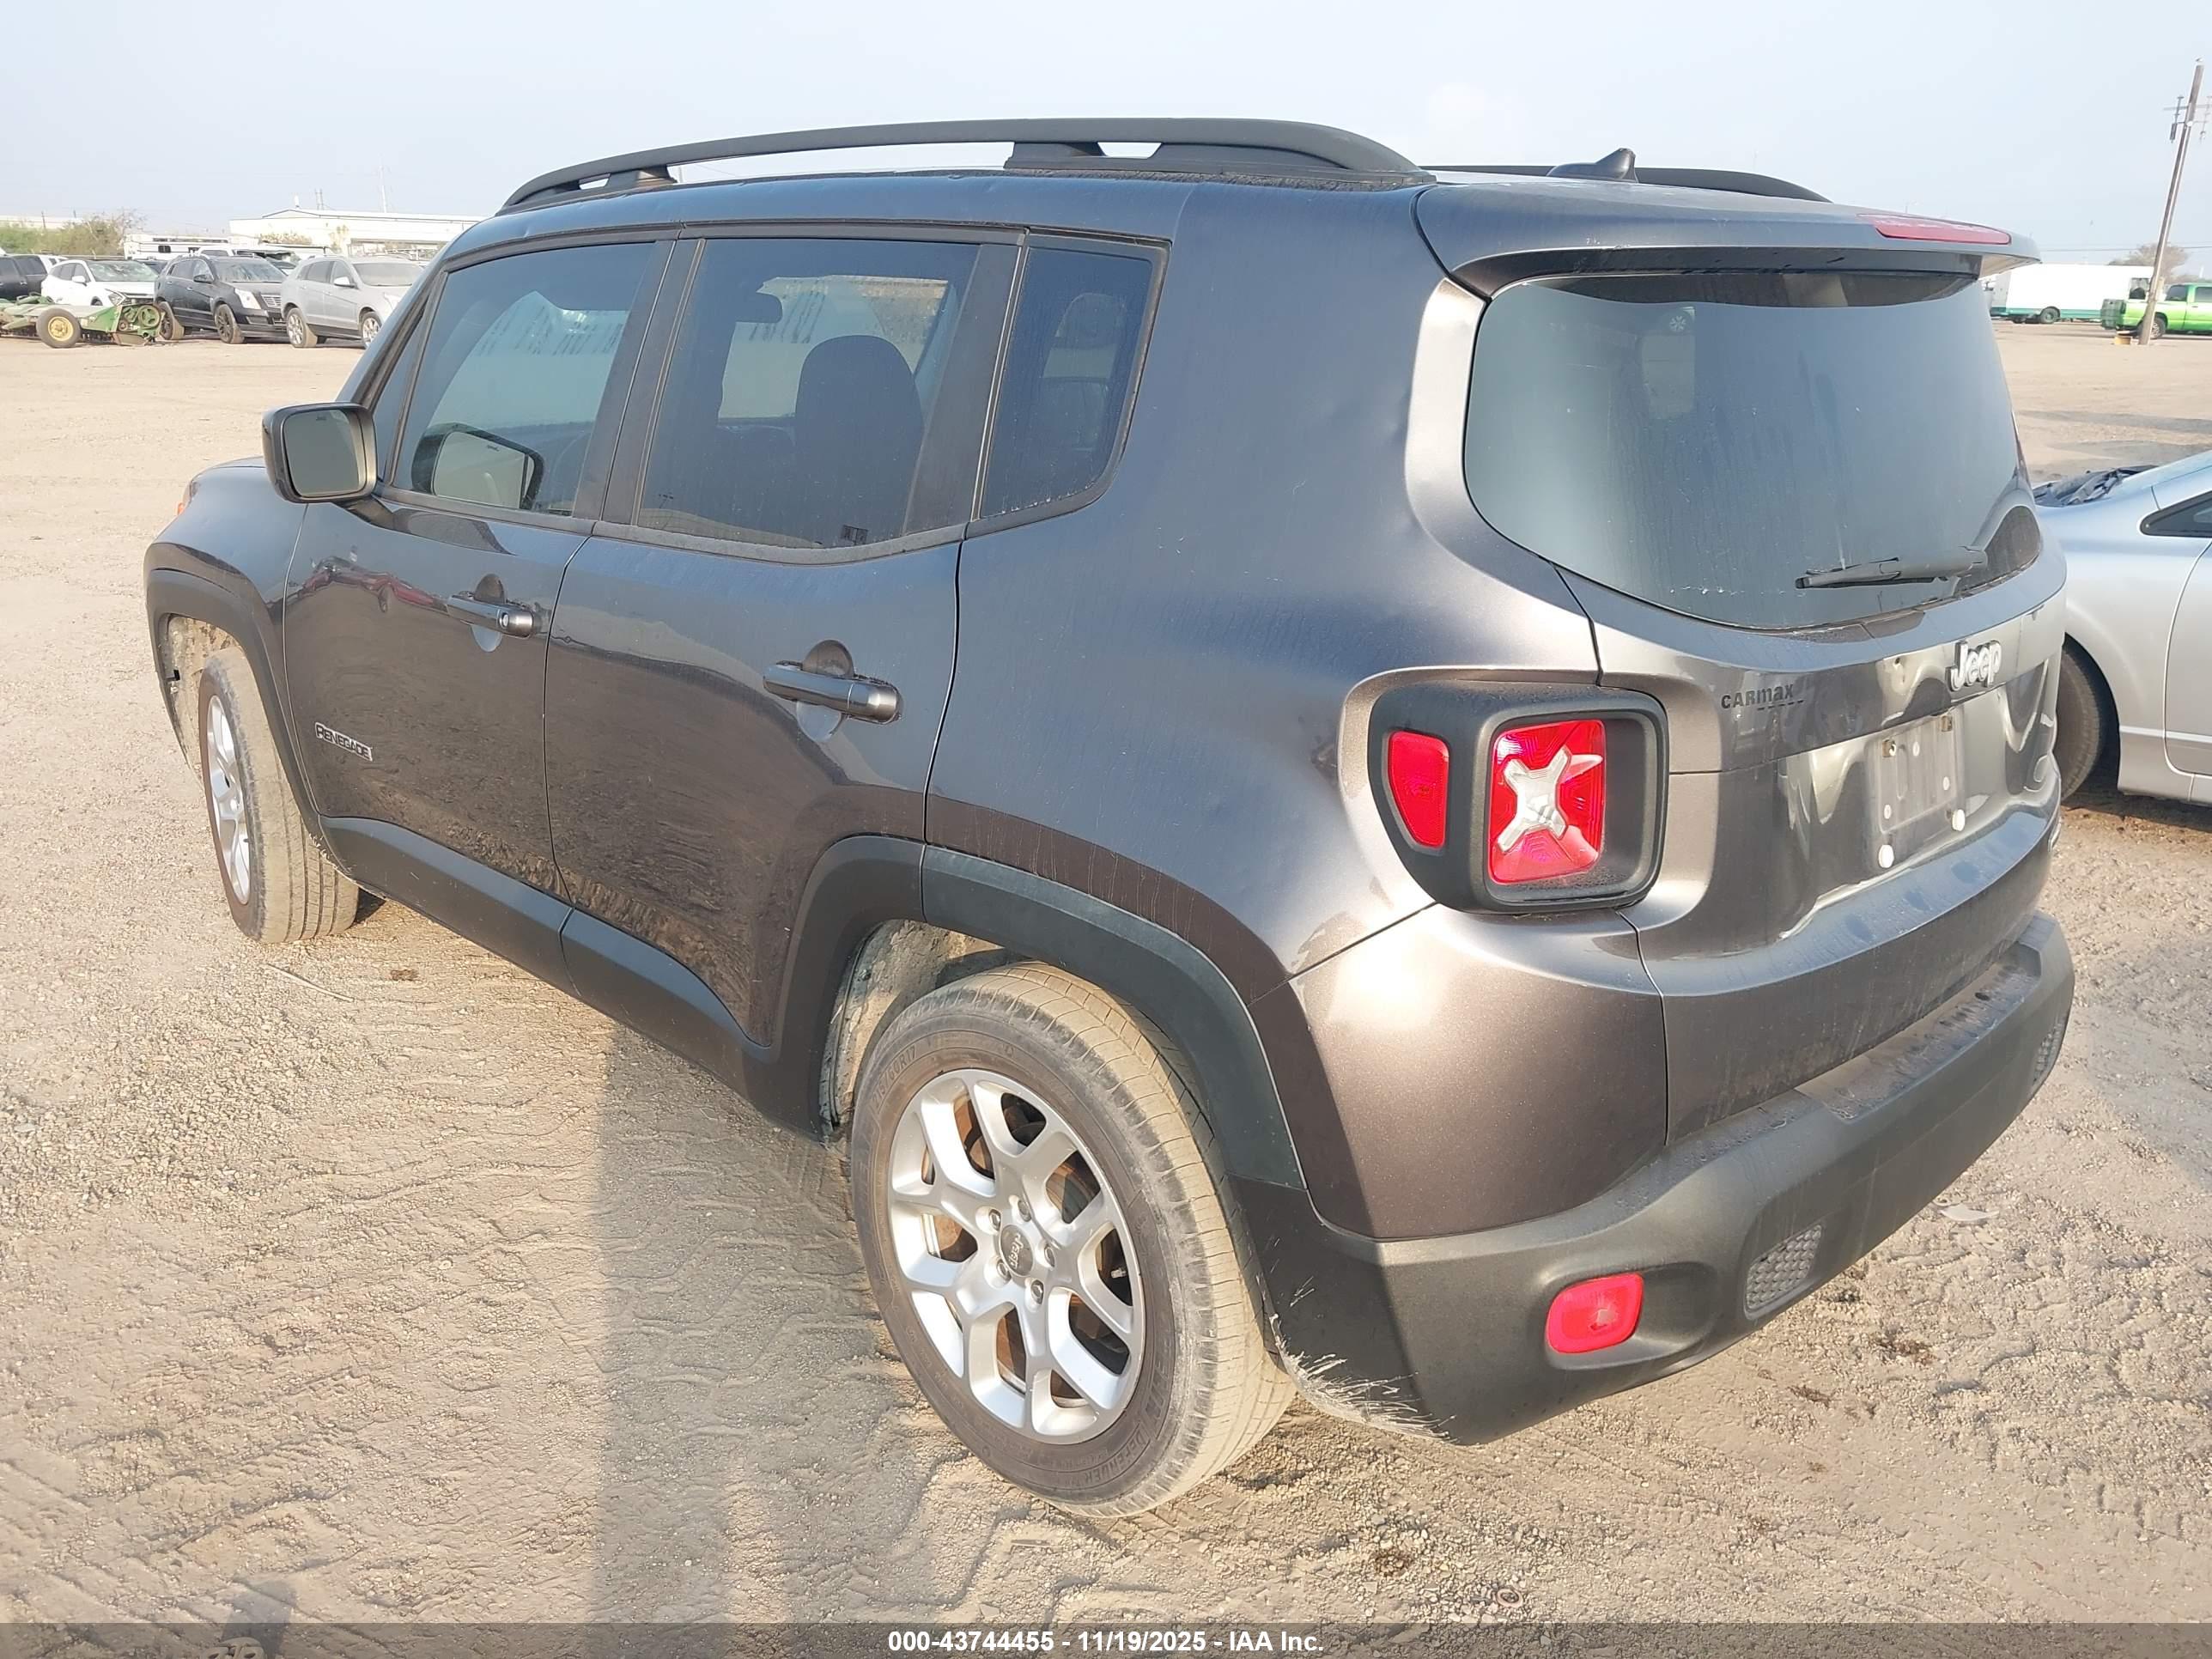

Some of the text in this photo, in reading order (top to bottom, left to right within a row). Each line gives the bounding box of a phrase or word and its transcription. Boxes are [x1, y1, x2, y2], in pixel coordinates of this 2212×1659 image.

[1945, 640, 2002, 691] Jeep
[314, 722, 373, 762] RENEGADE
[1008, 1232, 1024, 1270] Jeep
